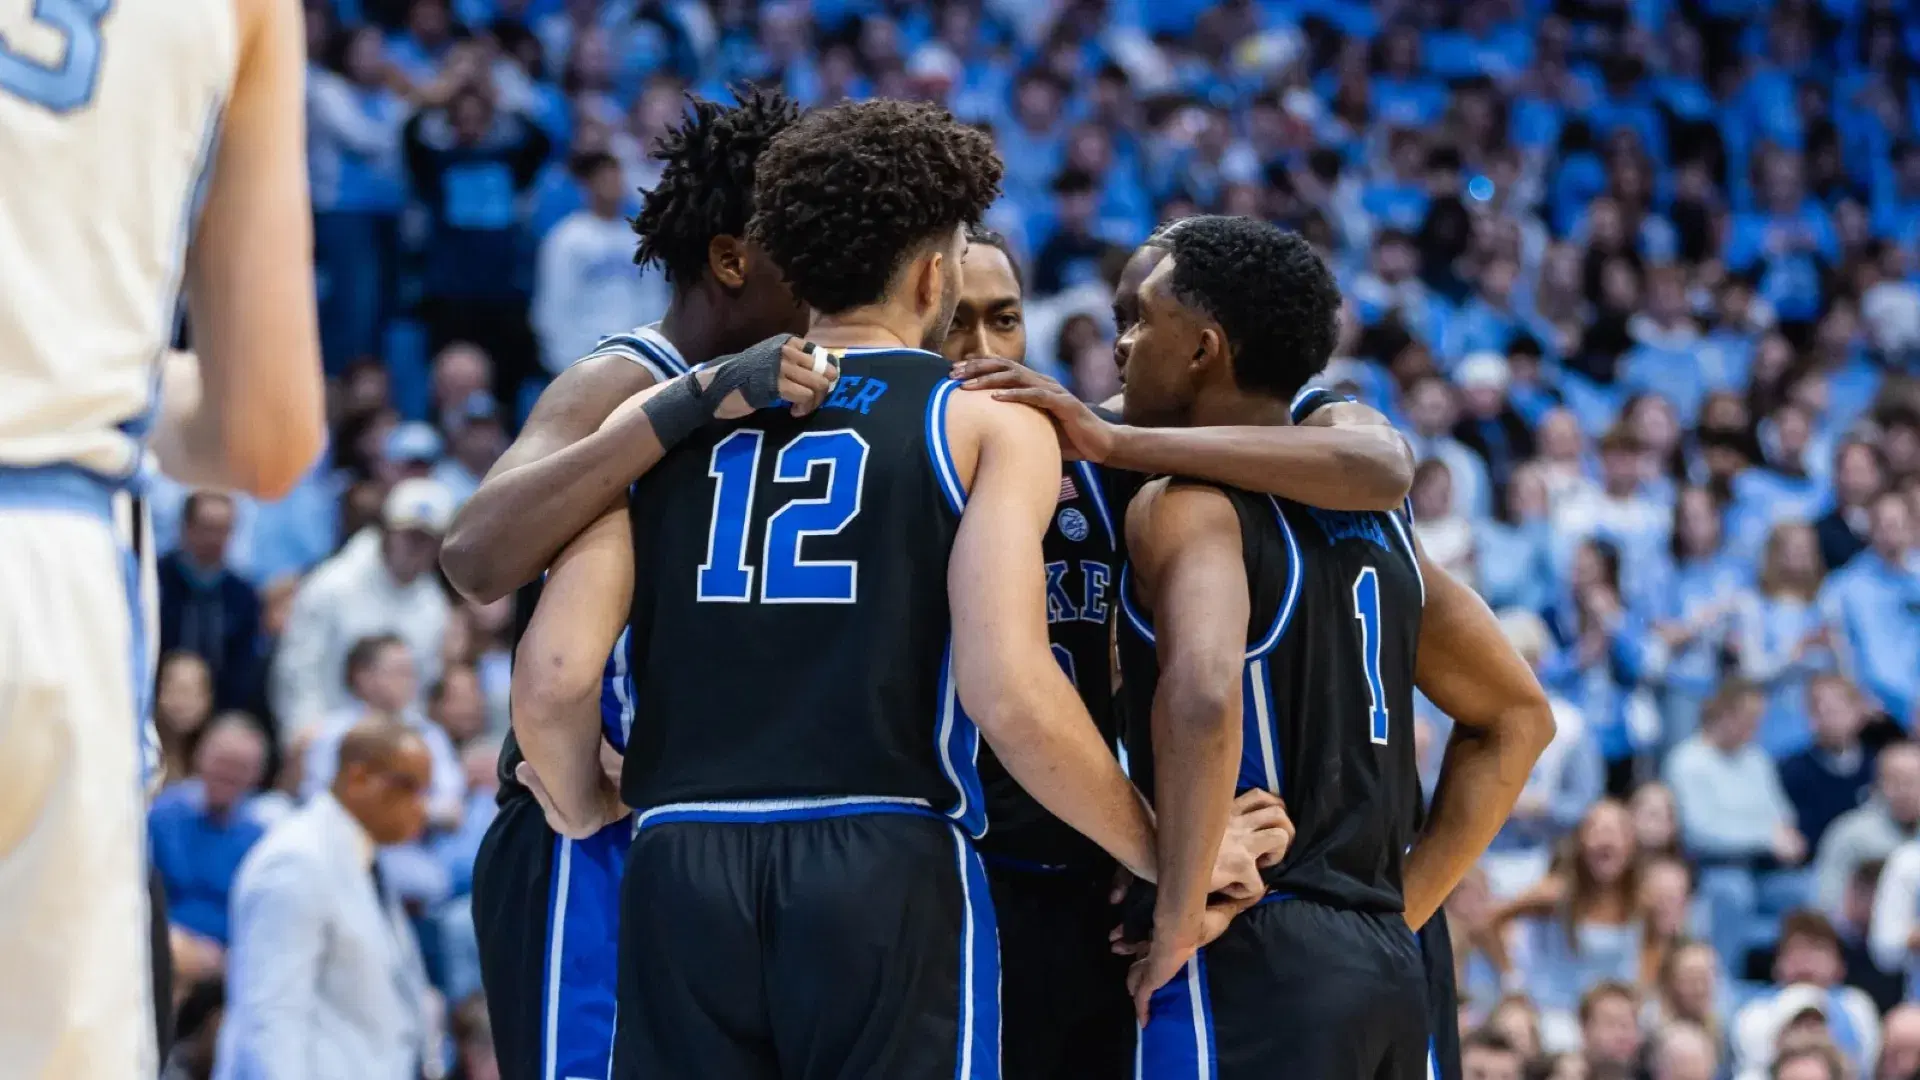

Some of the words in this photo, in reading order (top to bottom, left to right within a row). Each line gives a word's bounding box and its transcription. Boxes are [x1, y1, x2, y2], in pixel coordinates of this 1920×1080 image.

[697, 427, 871, 604] 12
[1044, 559, 1112, 625] KE
[1352, 566, 1389, 746] 1
